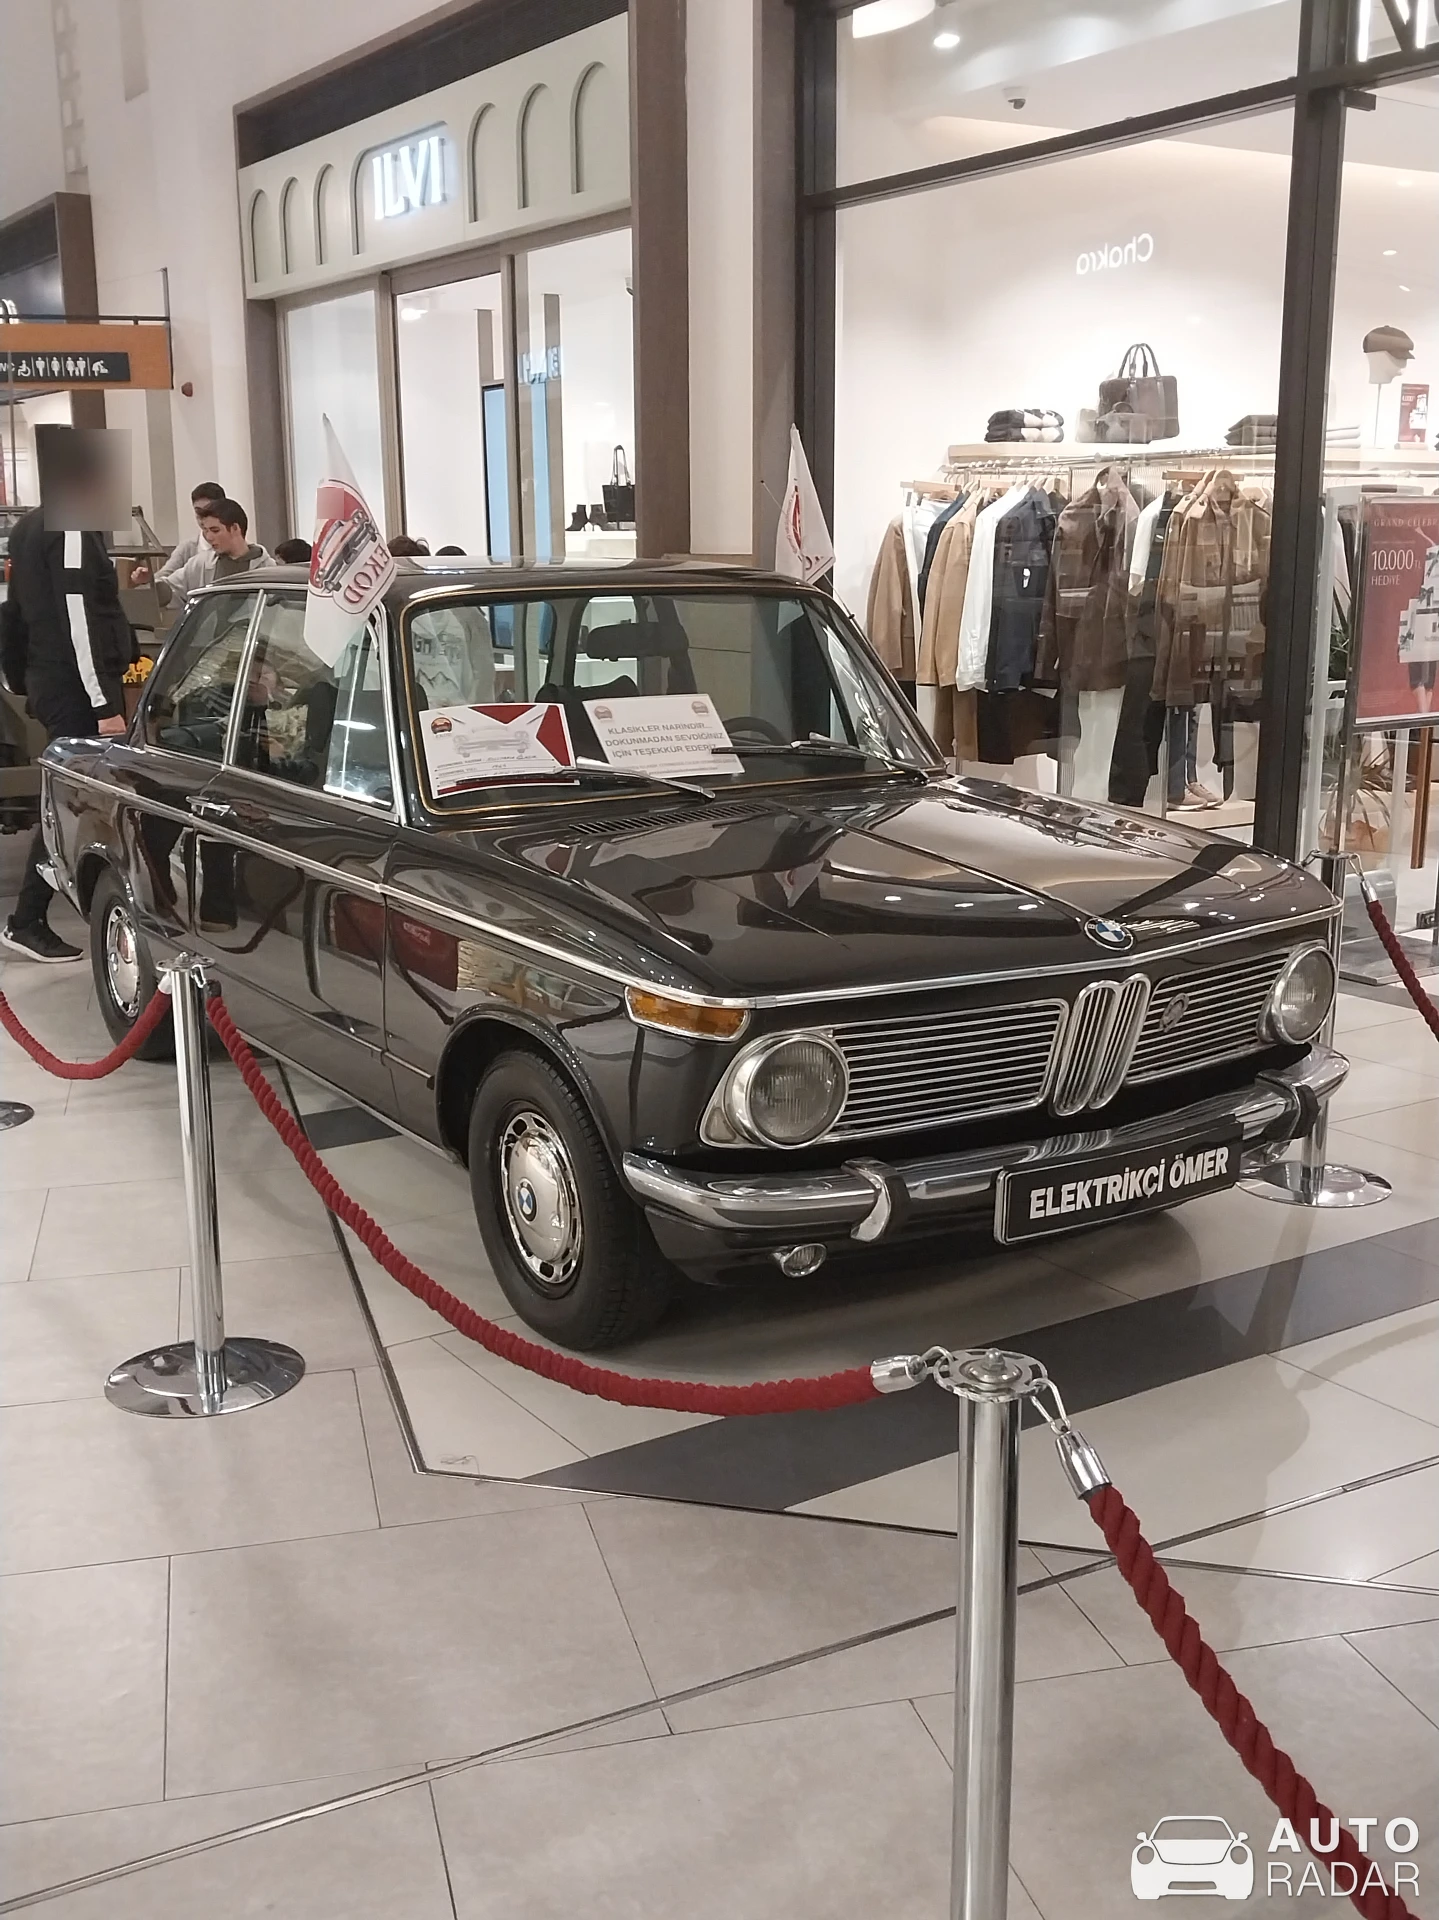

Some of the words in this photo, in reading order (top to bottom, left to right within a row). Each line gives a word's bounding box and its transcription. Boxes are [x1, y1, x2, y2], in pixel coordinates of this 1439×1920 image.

[372, 136, 442, 220] ILVI
[1374, 518, 1404, 527] GRAND
[1371, 549, 1414, 571] 10.000
[608, 723, 660, 735] KLASİKLER
[605, 735, 673, 747] DOKUNMADAN
[675, 732, 725, 742] SEVDİĞİNİZ
[612, 748, 632, 758] İÇİN
[635, 746, 683, 756] TEŞEKKÜR
[1029, 1158, 1166, 1219] ELEKTRİKÇİ
[1169, 1147, 1229, 1189] ÖMER
